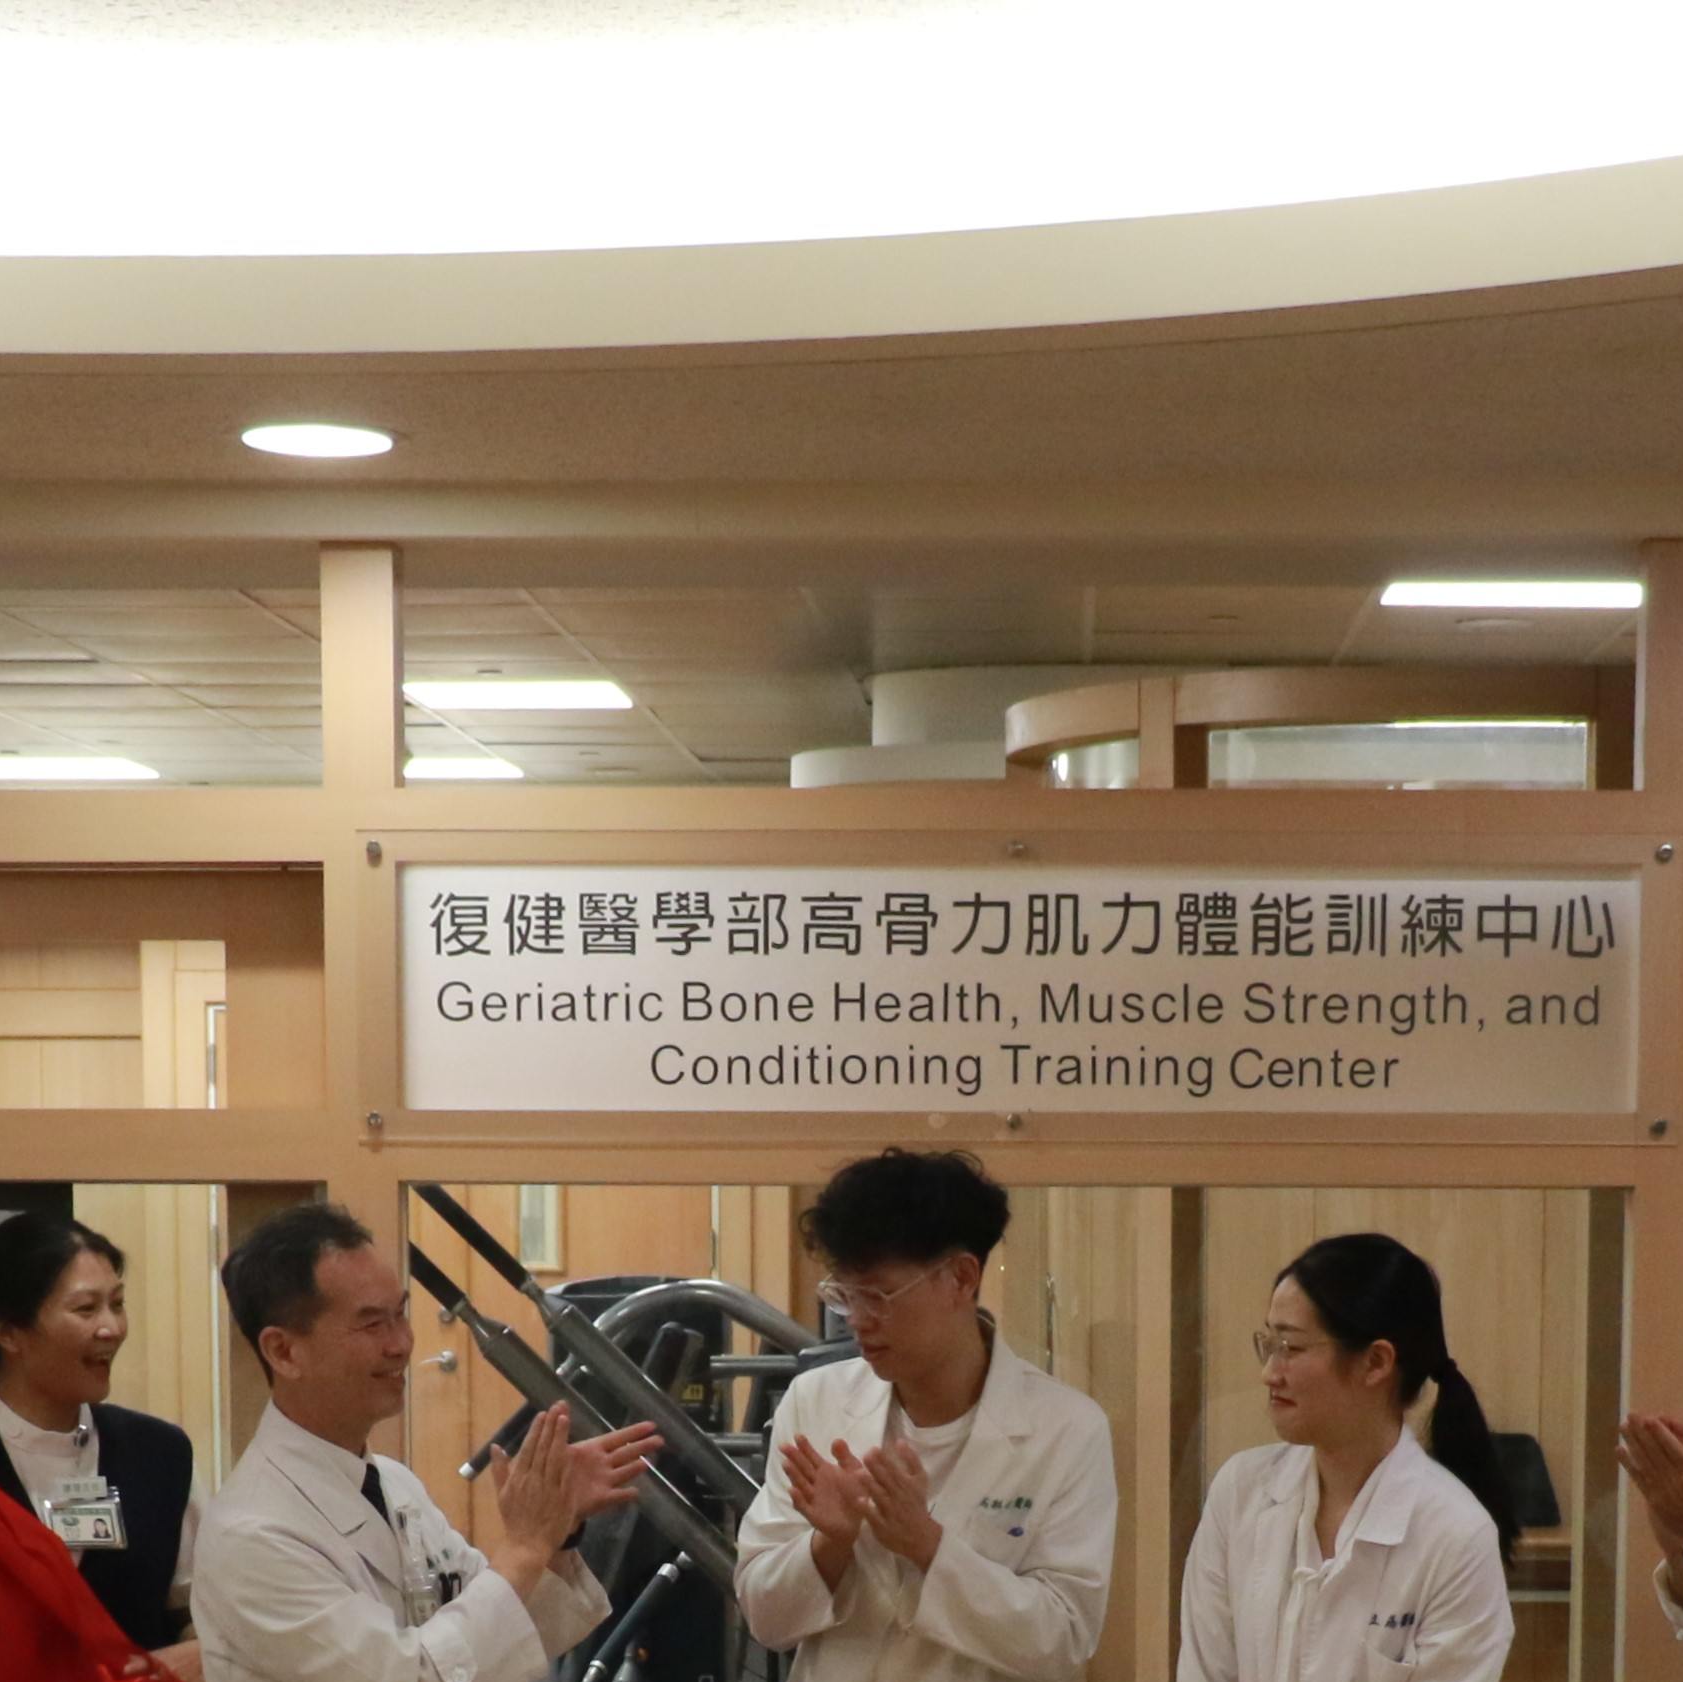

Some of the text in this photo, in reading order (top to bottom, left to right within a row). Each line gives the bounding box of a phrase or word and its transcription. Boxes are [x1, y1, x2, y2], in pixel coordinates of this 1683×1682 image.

[429, 891, 1616, 959] 復健醫學部高骨力肌力體能訓練中心
[436, 980, 1601, 1034] Geriatric Bone Health, Muscle Strength, and
[650, 1043, 1400, 1098] Conditioning Training Center
